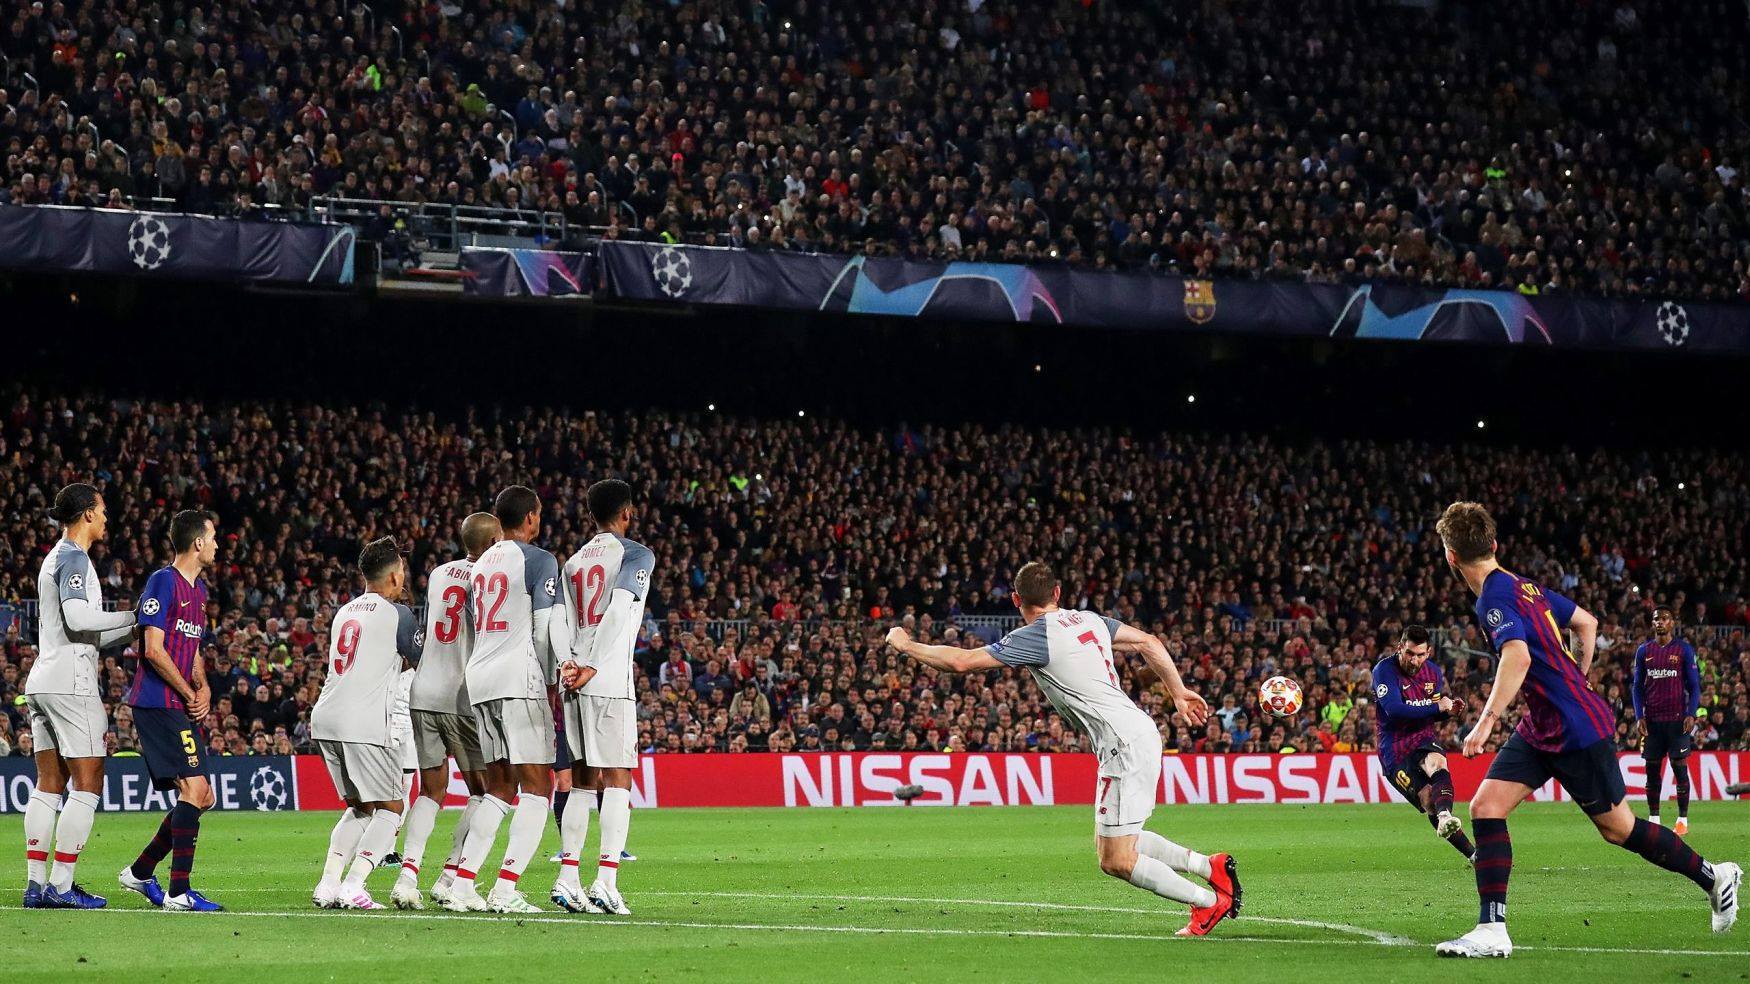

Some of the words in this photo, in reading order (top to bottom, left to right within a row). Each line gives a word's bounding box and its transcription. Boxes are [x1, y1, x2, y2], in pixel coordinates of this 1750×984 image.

[435, 585, 467, 644] 3
[473, 571, 509, 634] 32
[570, 565, 605, 629] 12
[334, 619, 361, 676] 9
[180, 729, 196, 754] 5
[103, 773, 239, 811] LEAE
[782, 755, 1054, 807] NISSAN
[1101, 776, 1112, 803] 7
